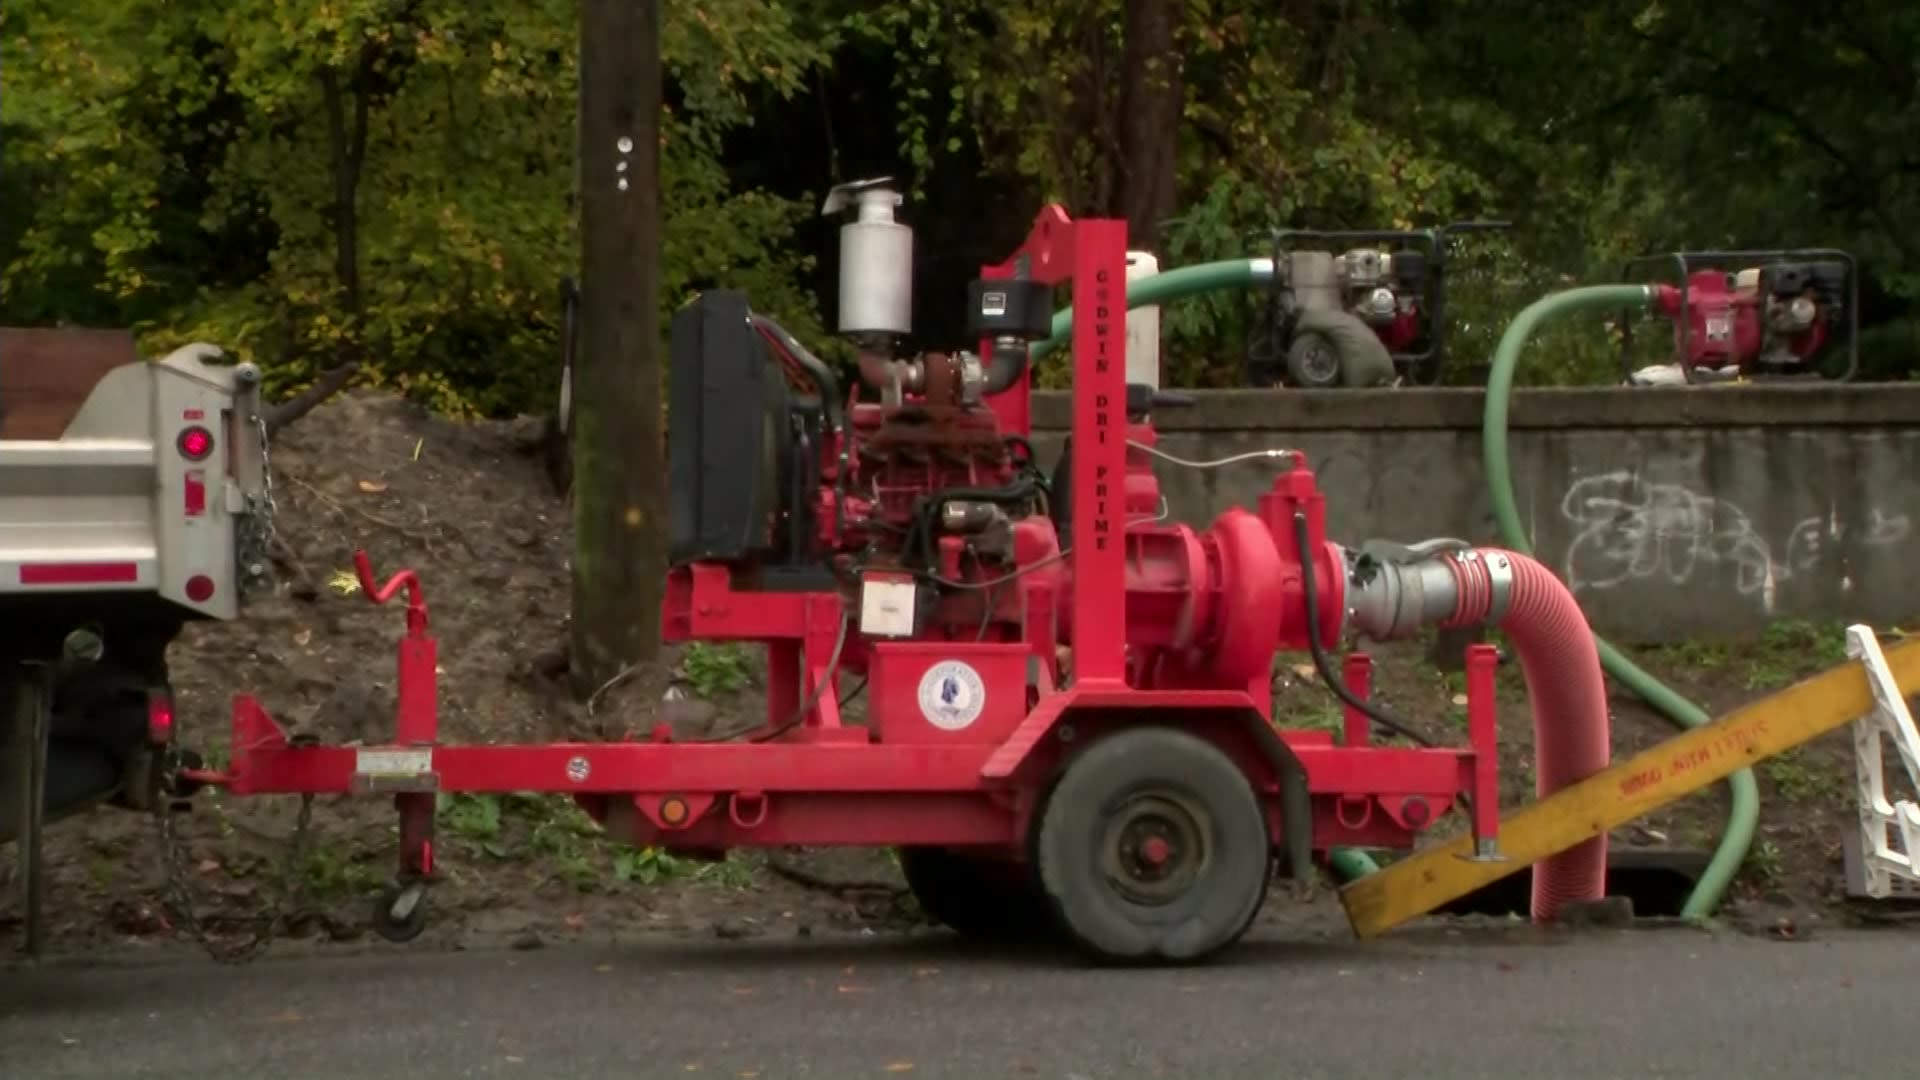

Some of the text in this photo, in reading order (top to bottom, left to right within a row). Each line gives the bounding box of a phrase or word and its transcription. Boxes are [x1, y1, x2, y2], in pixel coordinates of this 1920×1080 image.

[1094, 269, 1109, 550] GODWIN DRI PRIME
